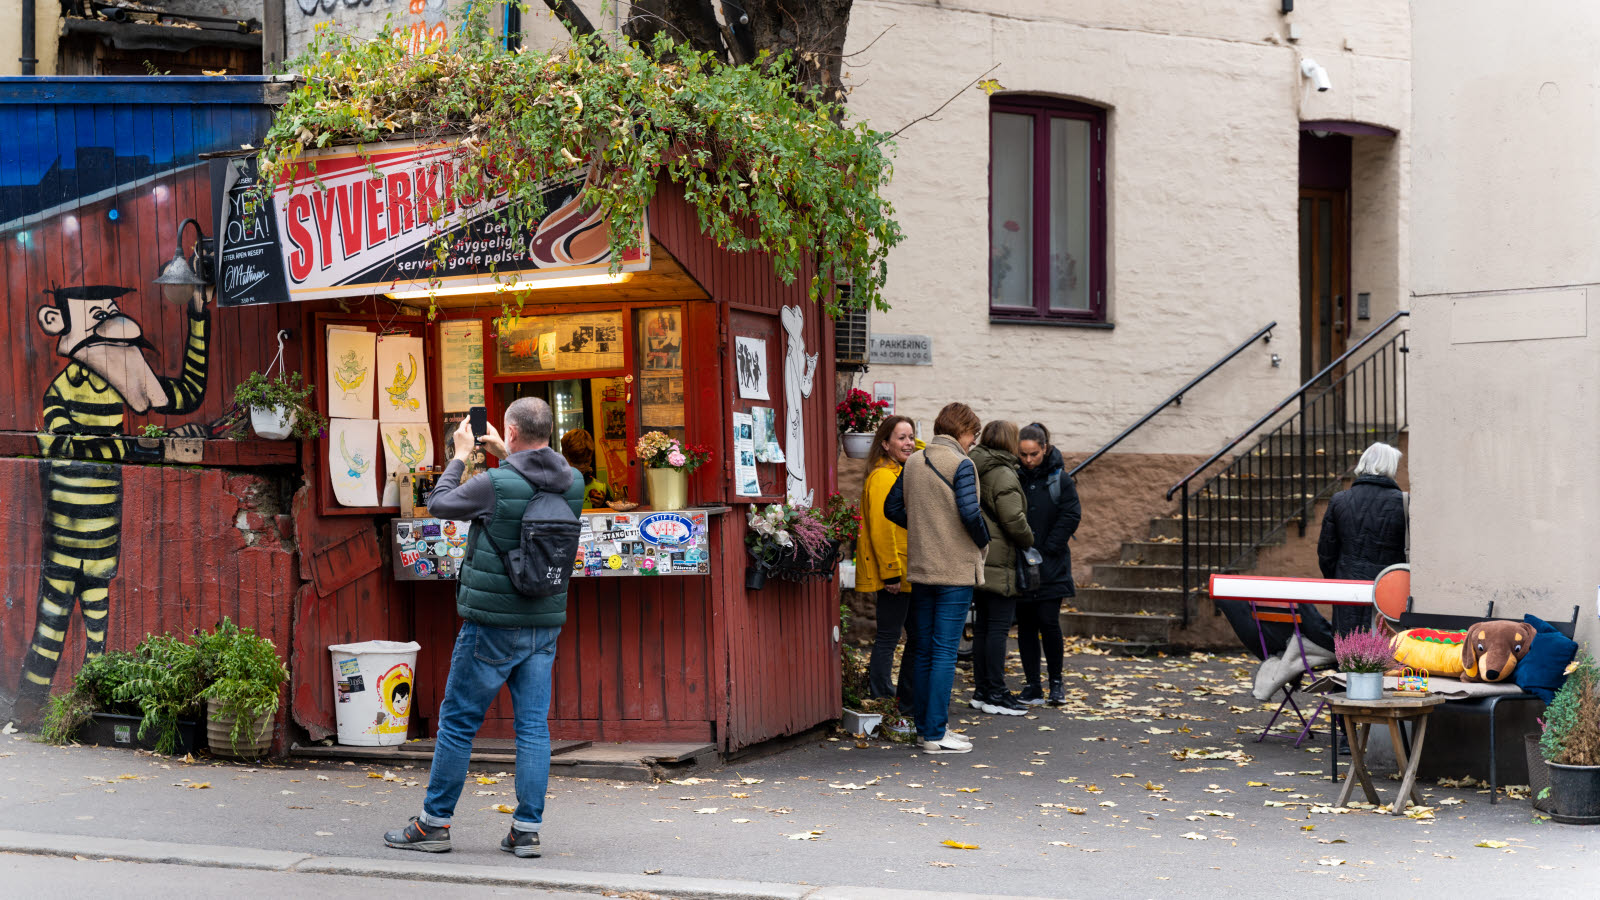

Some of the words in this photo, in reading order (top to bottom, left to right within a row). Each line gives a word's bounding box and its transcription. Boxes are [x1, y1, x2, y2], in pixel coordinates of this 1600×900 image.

[224, 215, 270, 246] OLA!
[450, 253, 481, 269] gode
[485, 250, 526, 266] pølser
[880, 340, 927, 350] PARKERING
